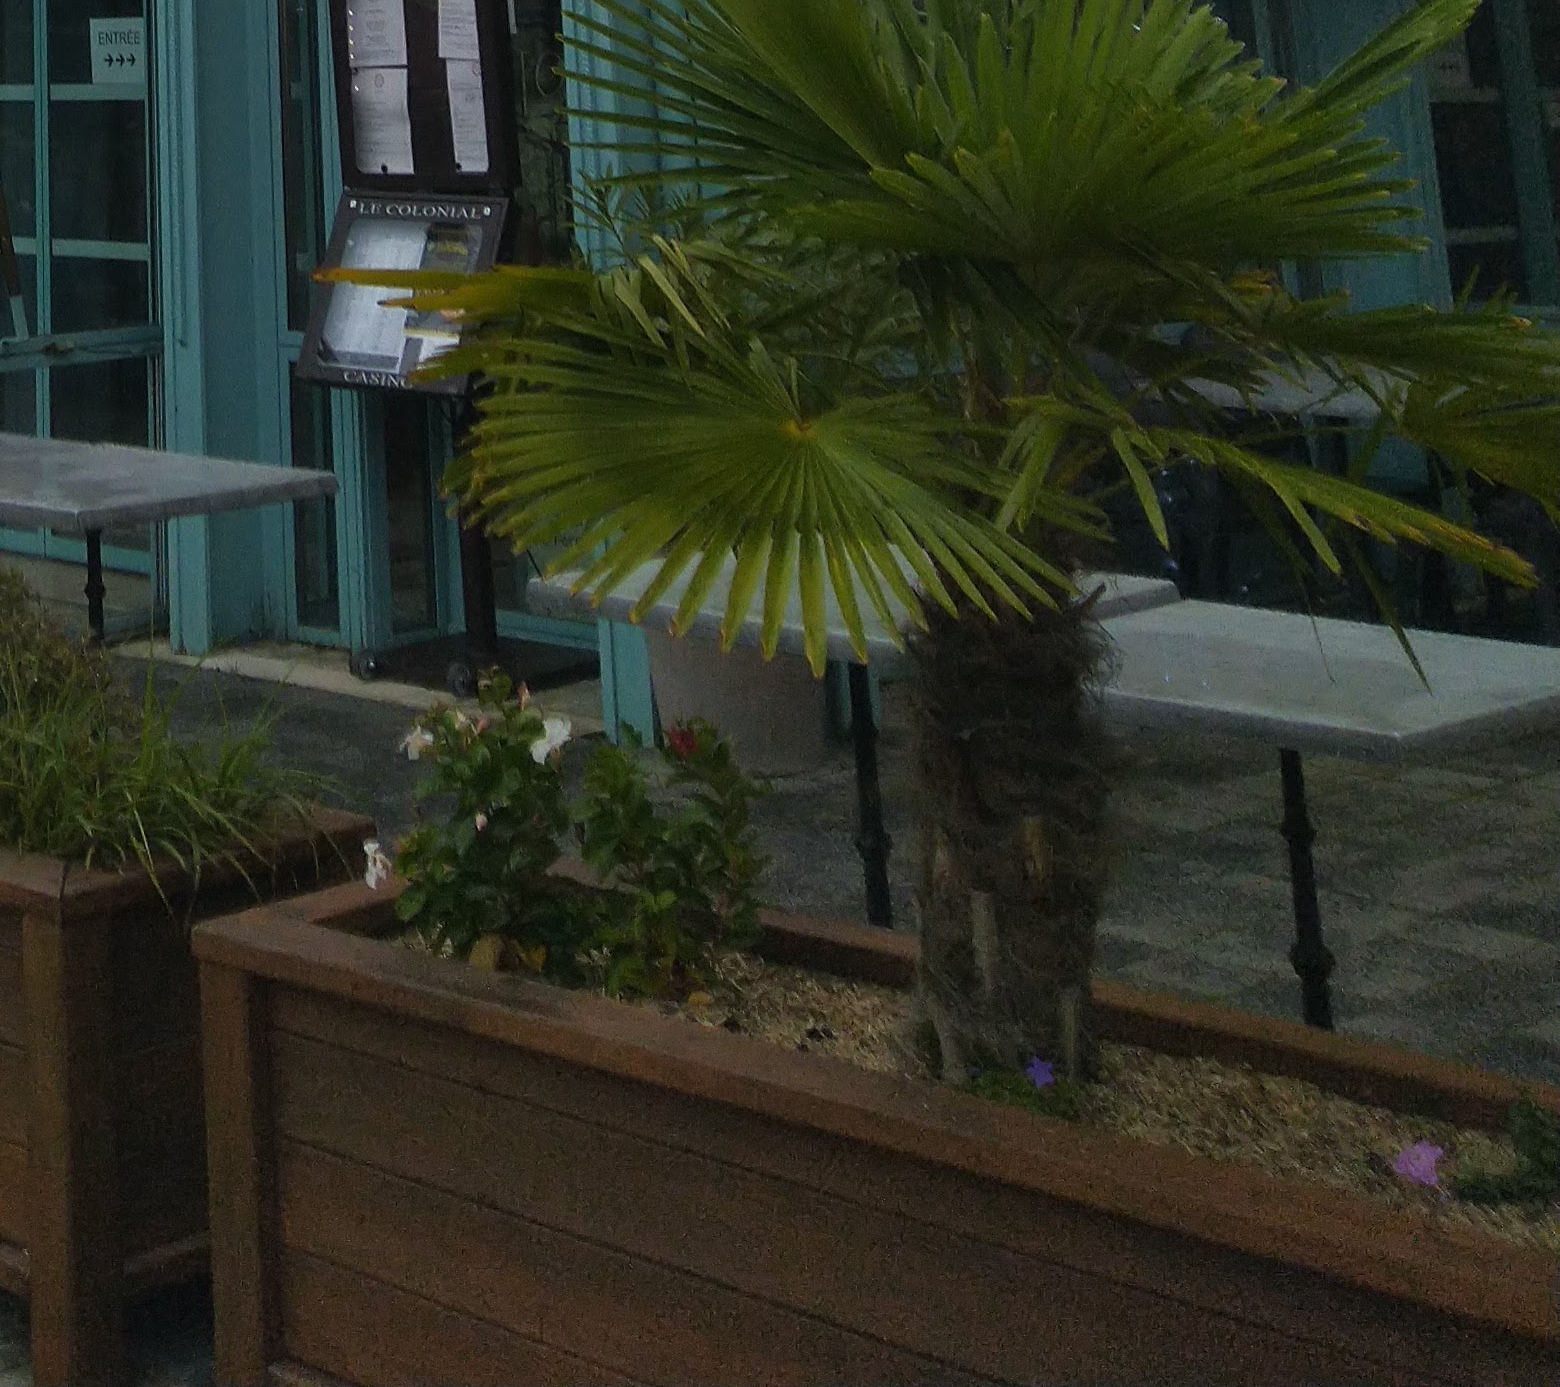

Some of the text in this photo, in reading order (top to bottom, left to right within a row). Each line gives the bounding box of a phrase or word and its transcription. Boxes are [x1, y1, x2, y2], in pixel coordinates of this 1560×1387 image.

[98, 28, 141, 45] ENTRÉE
[359, 201, 482, 220] LE COLONIAL
